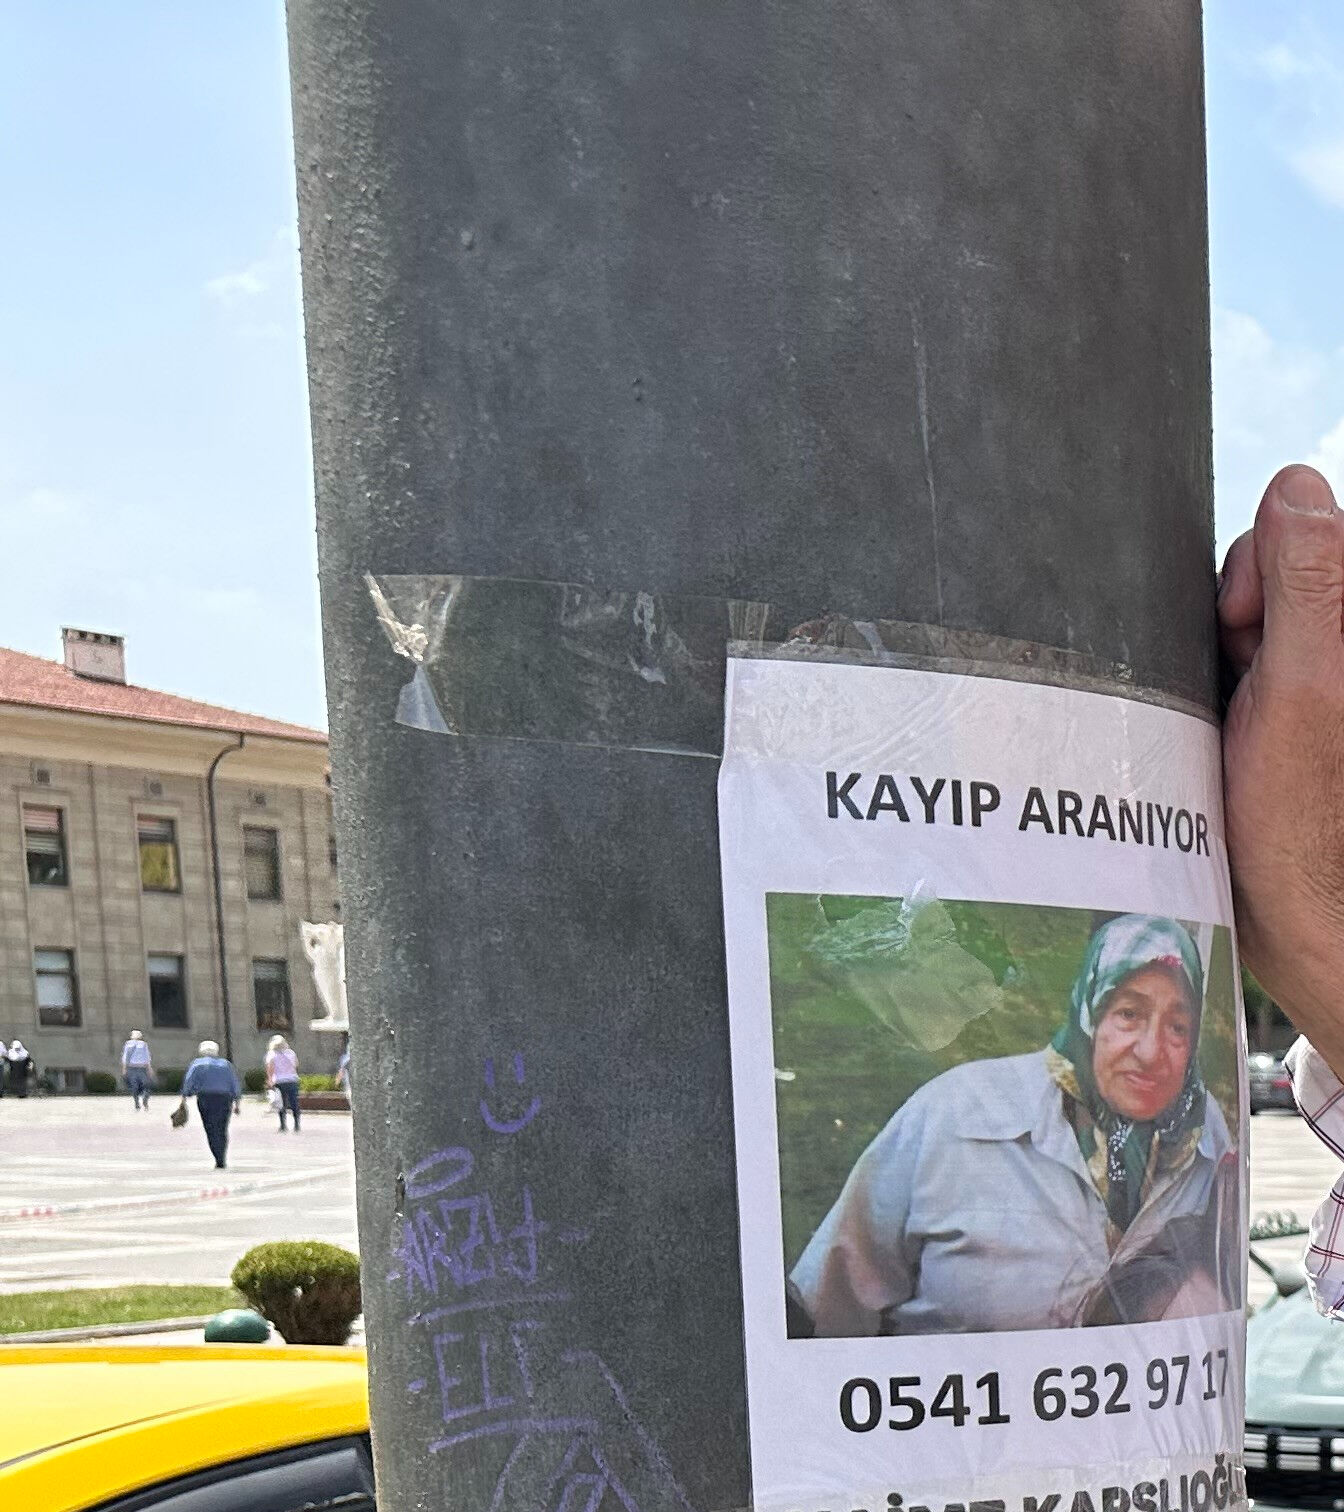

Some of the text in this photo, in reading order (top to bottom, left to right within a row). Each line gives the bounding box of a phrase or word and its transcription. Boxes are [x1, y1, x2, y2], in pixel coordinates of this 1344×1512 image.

[825, 770, 1210, 857] KAYIP ARANIYOR
[839, 1348, 1229, 1433] 0541 632 97 17
